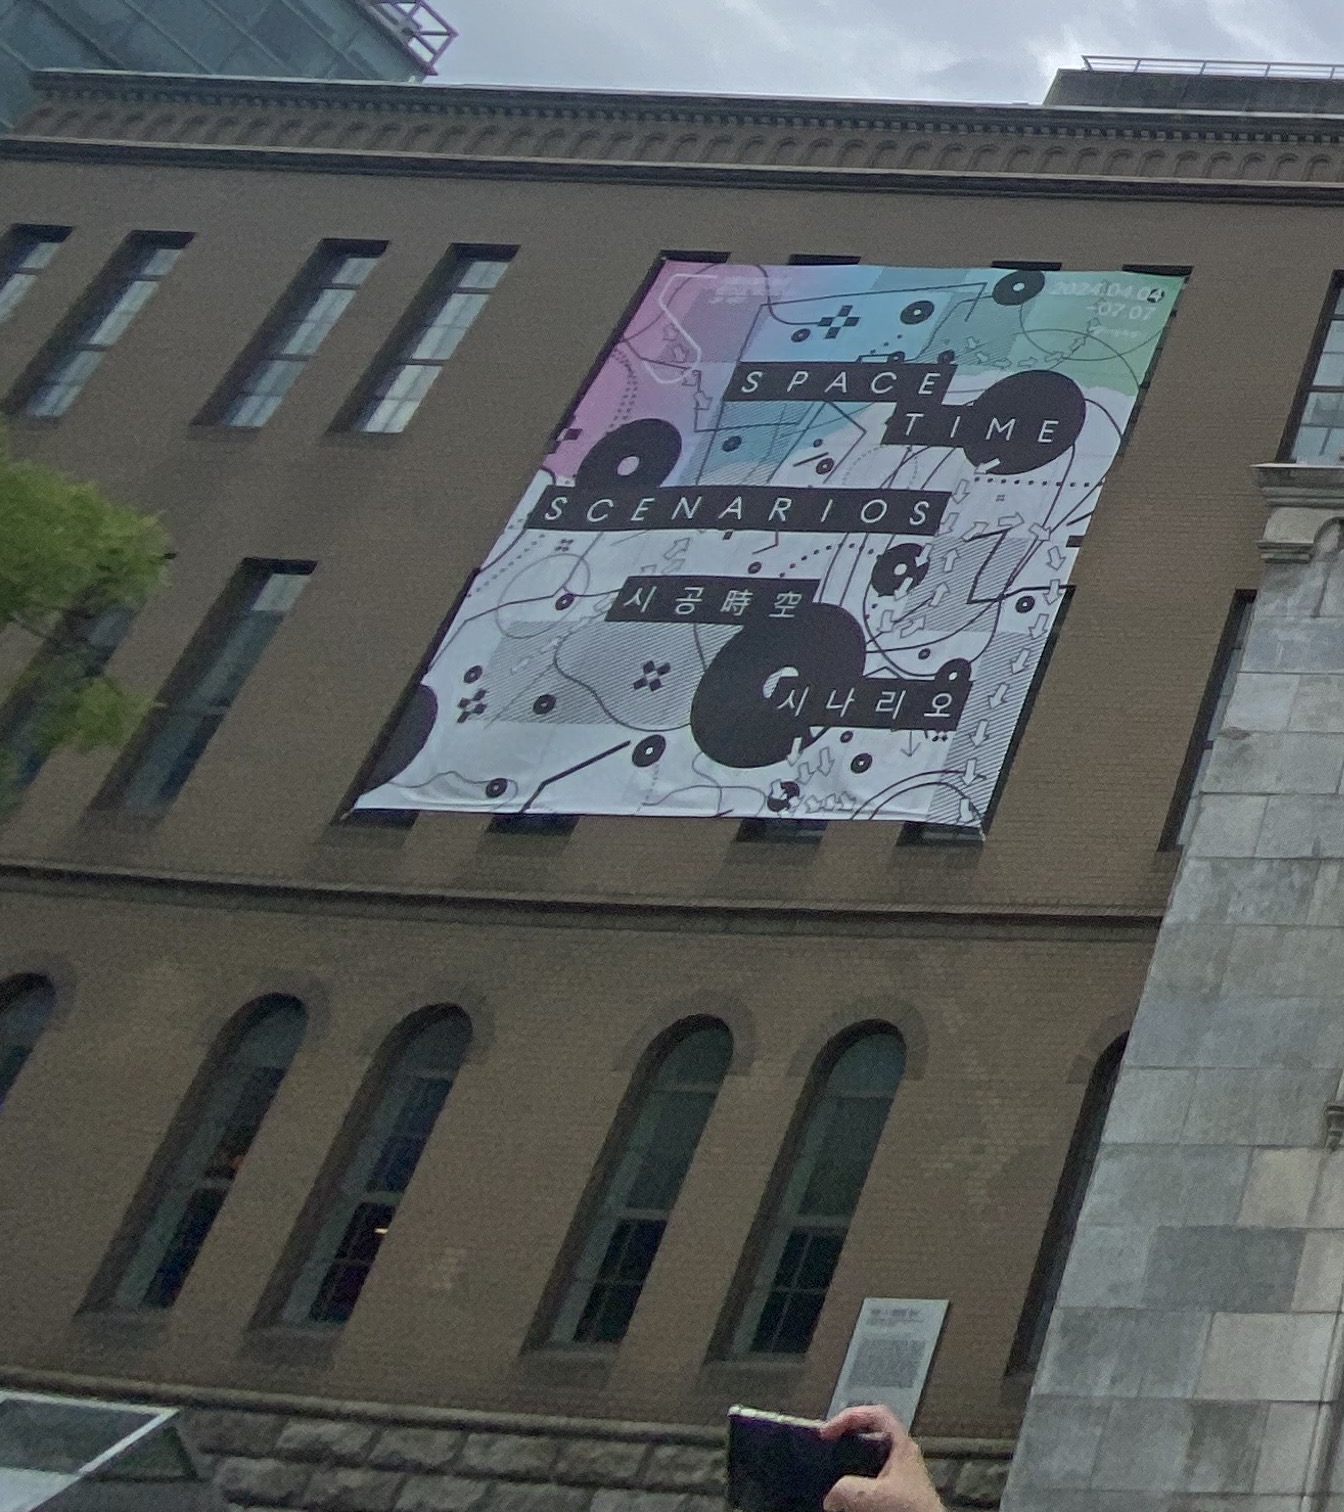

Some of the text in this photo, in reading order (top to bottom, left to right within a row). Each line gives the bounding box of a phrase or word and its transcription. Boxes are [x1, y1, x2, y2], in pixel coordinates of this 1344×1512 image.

[741, 371, 941, 396] SPACE
[905, 413, 1059, 443] TIME
[544, 496, 929, 526] SCENARIOS
[777, 687, 953, 719] 시나리오
